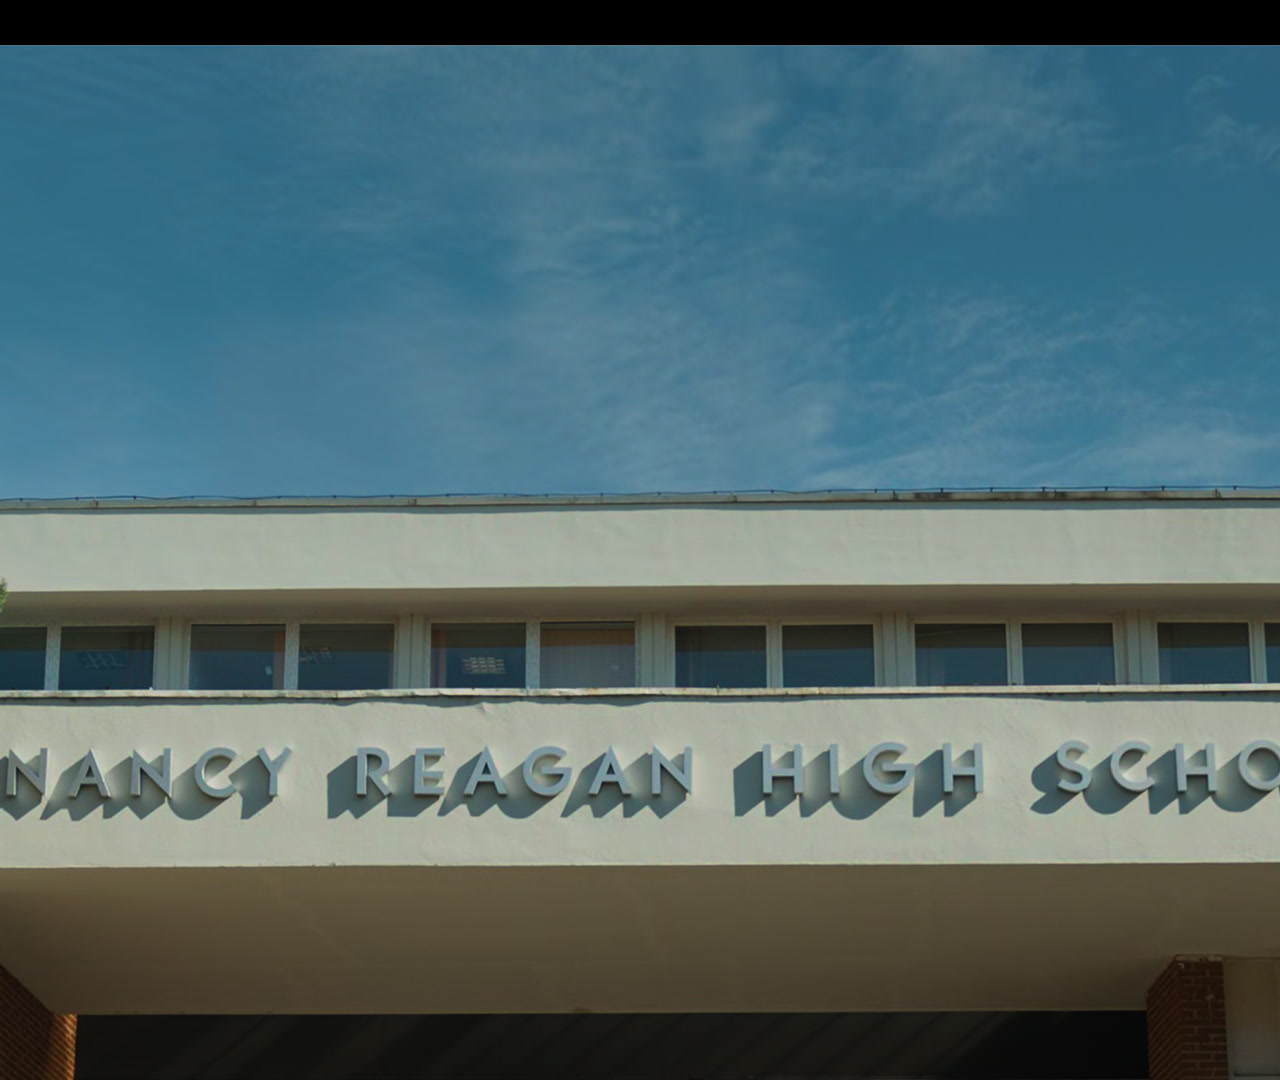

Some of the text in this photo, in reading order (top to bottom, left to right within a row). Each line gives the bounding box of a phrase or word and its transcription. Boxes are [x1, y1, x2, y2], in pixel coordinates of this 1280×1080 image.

[5, 746, 293, 799] NANCY
[355, 745, 694, 798] REAGAN
[761, 740, 985, 796] HIGH
